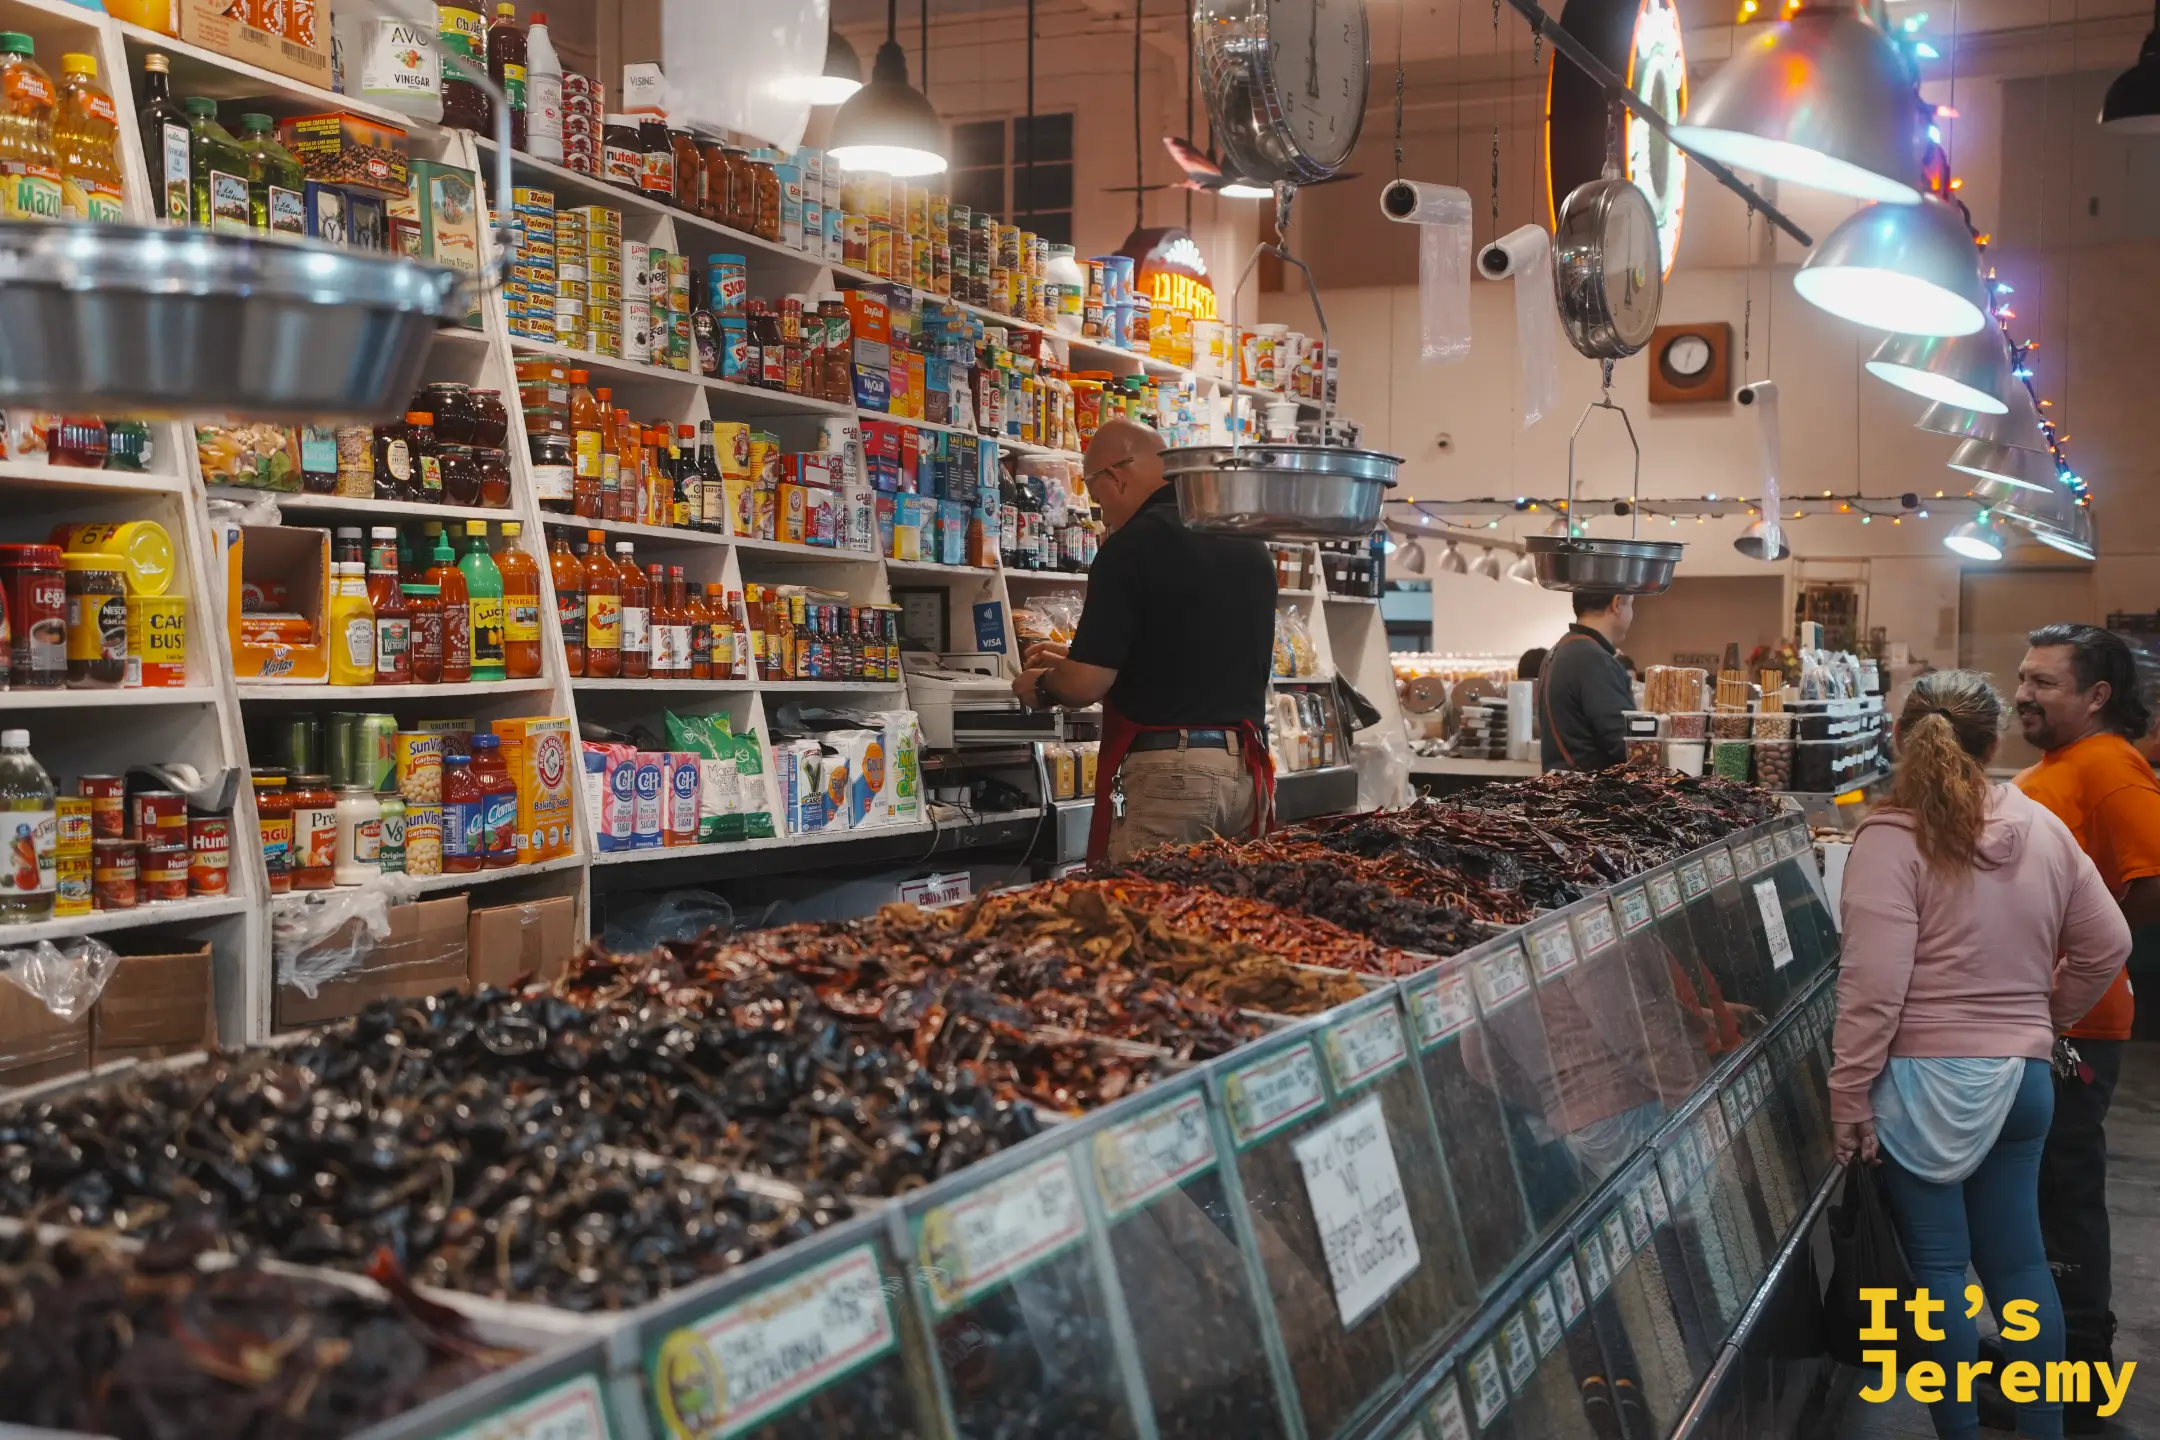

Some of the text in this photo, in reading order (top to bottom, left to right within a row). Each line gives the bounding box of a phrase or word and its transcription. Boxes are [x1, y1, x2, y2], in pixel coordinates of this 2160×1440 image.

[394, 73, 430, 88] VINEGAR
[630, 76, 655, 86] VISINE
[606, 151, 642, 167] nutella
[369, 162, 387, 176] Legal
[864, 304, 884, 318] DayQuil
[864, 379, 885, 393] NyQuil
[983, 638, 1001, 647] VISA
[452, 722, 468, 730] SIZE!
[536, 723, 551, 731] VALUE
[638, 771, 659, 791] C&H
[676, 771, 695, 791] C&H
[534, 797, 569, 812] Baking Soda
[640, 820, 656, 830] SUGAR
[677, 818, 692, 828] SUGAR
[385, 822, 403, 843] V8
